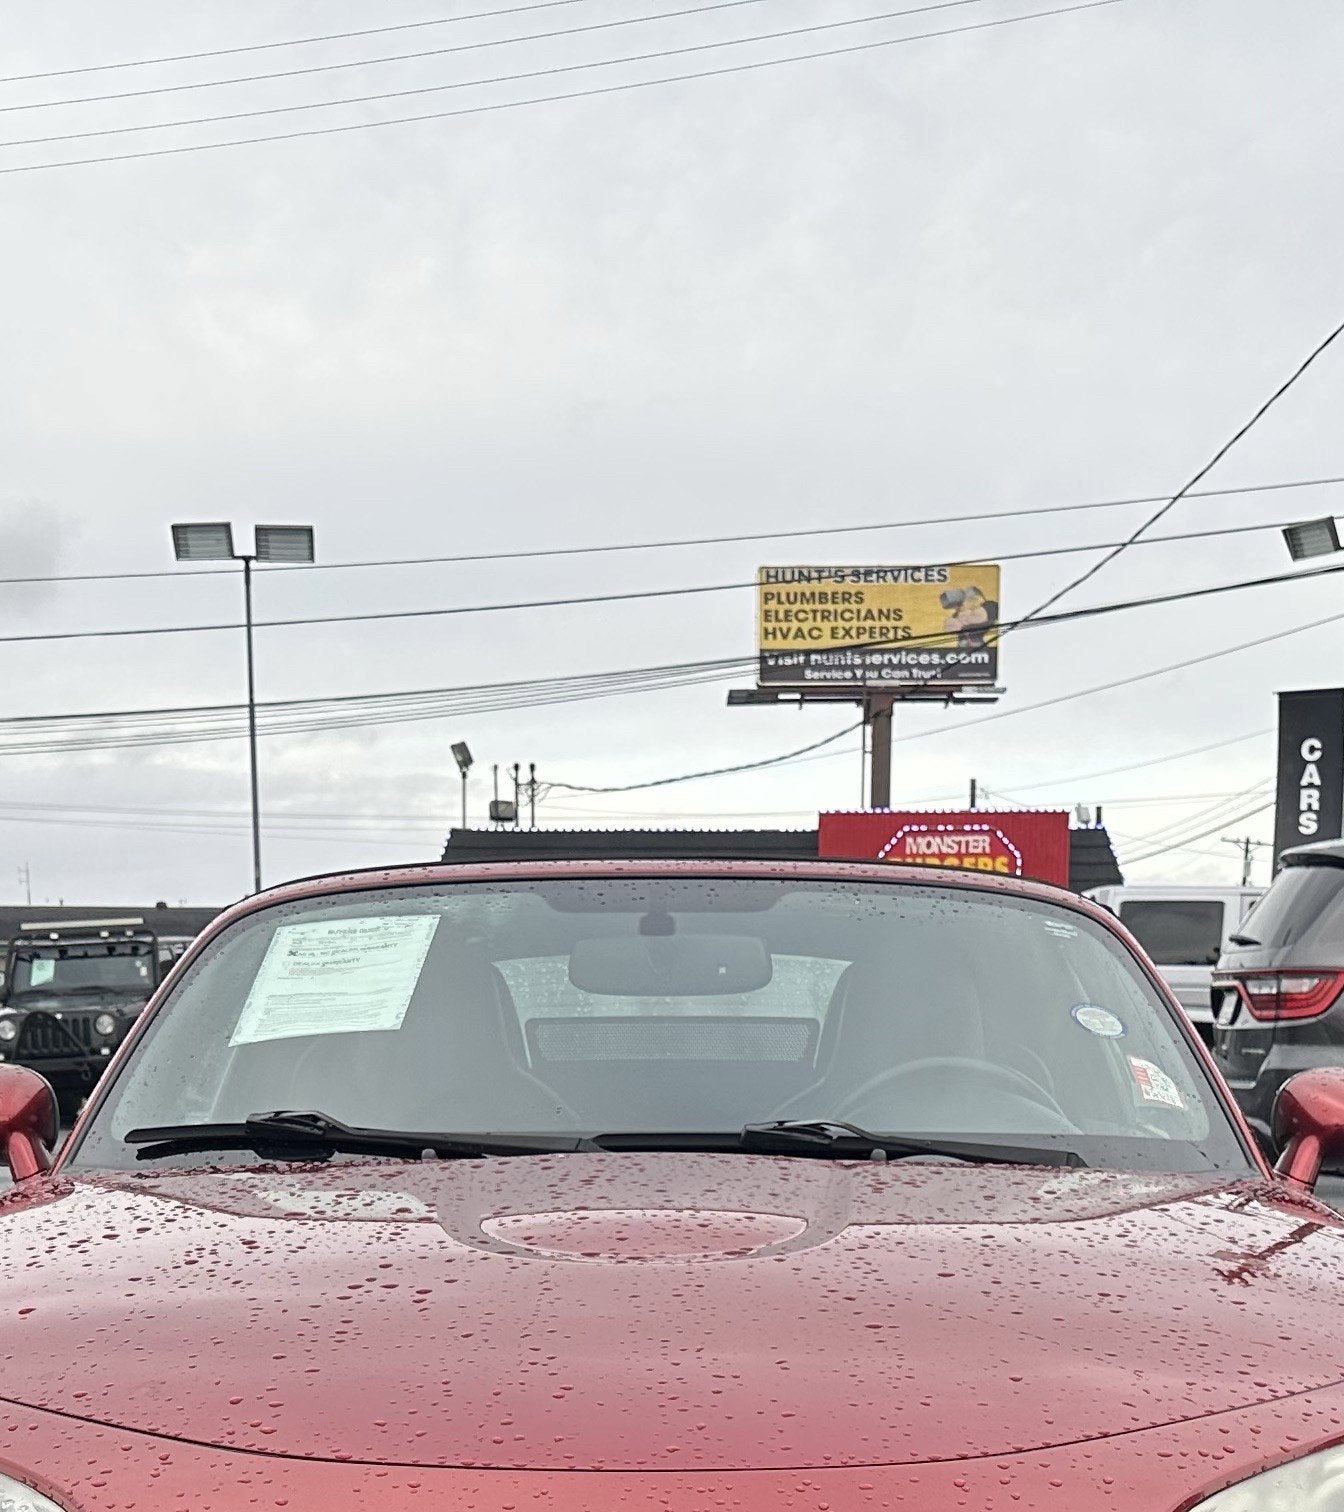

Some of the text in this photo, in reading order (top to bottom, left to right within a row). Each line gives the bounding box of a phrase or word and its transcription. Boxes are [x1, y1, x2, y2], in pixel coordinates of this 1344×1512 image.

[765, 567, 949, 584] HUNT'S SERVICES
[763, 591, 865, 605] PLUMBERS
[763, 608, 904, 623] ELECTRICIANS
[763, 626, 913, 640] HVAC EXPERTS
[767, 652, 805, 666] Visit
[804, 669, 853, 680] Service
[881, 669, 910, 679] Can
[1298, 737, 1323, 835] CARS
[906, 835, 990, 854] MONSTER
